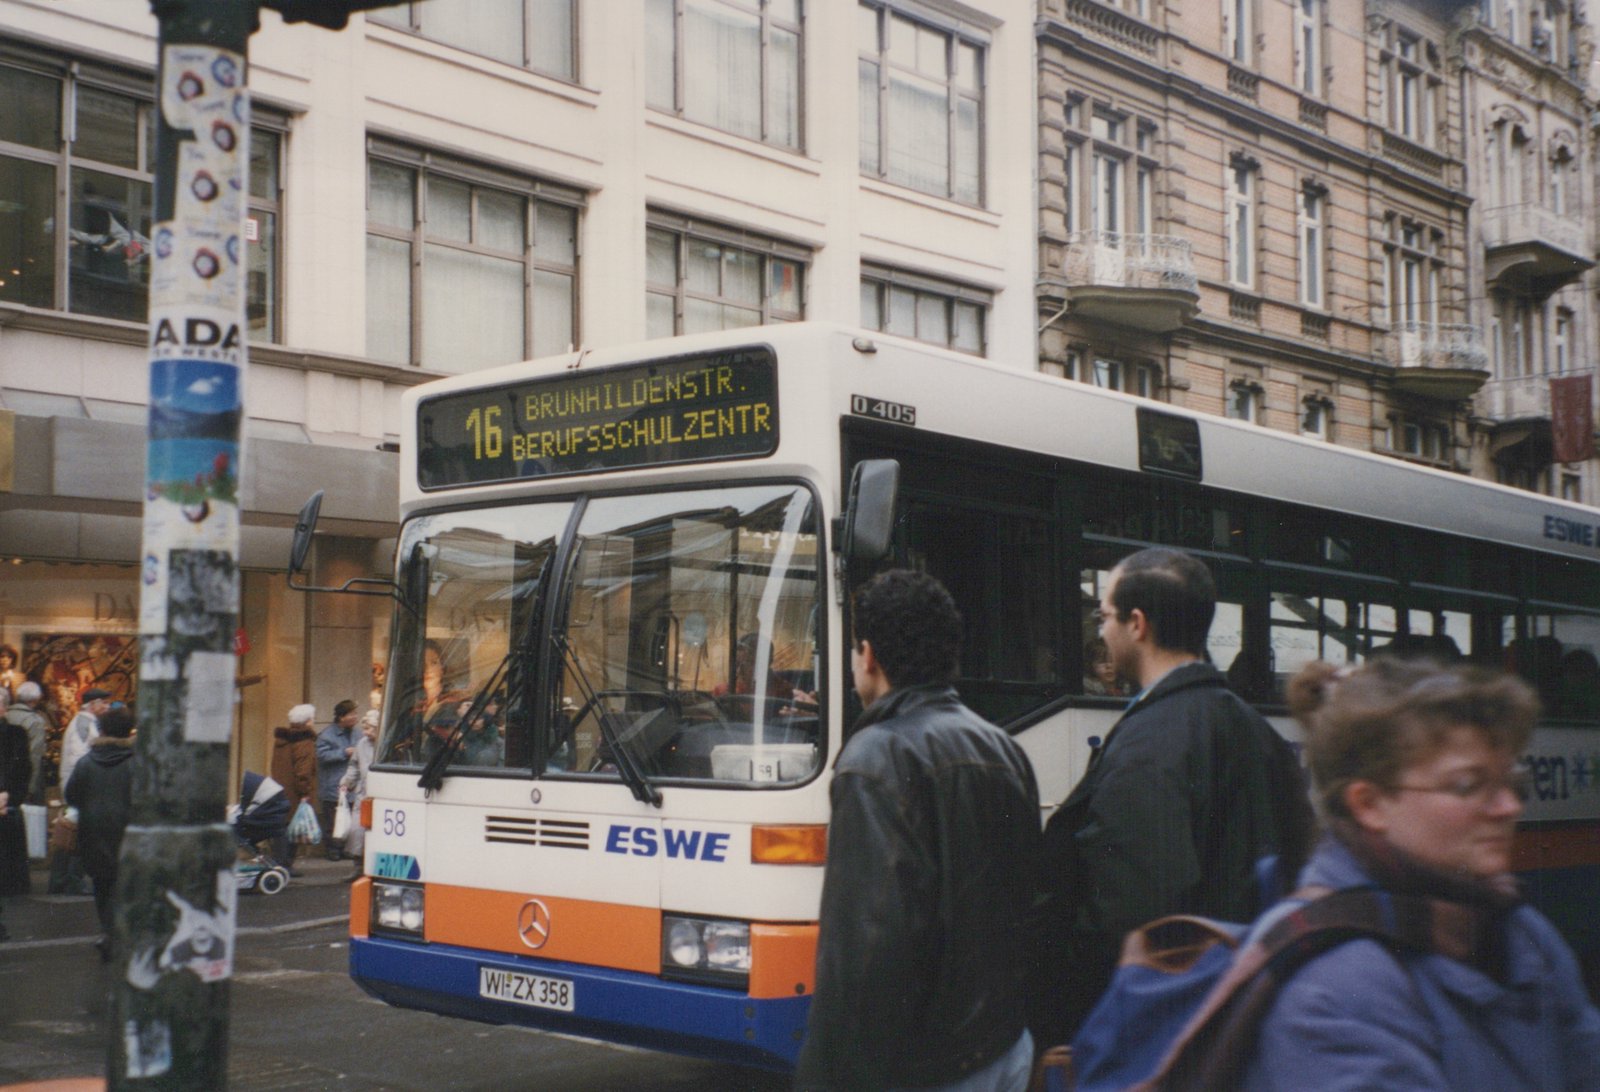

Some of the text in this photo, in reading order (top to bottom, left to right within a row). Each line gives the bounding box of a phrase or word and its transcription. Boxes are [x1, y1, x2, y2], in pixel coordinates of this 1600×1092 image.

[526, 366, 746, 411] BRUNHILDENSTR.
[512, 403, 770, 461] BERUFSSCHULZENTR
[872, 402, 915, 423] 405
[466, 405, 502, 460] 16
[383, 809, 406, 837] 58
[605, 824, 731, 863] ESWE
[539, 980, 570, 1007] 358
